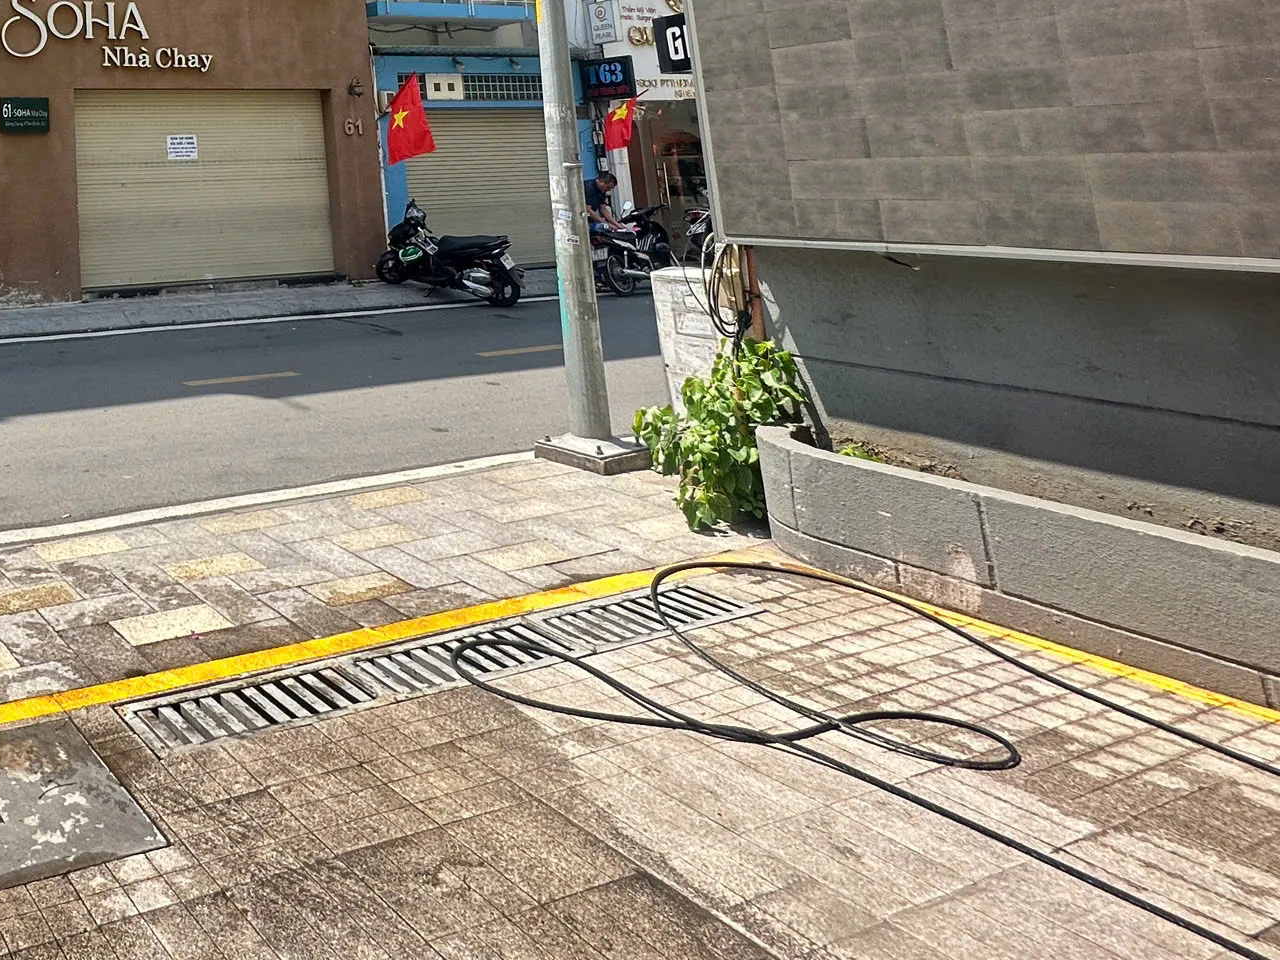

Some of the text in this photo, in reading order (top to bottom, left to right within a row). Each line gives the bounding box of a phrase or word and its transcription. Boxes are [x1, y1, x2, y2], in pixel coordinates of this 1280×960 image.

[102, 46, 214, 73] Nhà Chay
[344, 118, 363, 135] 61
